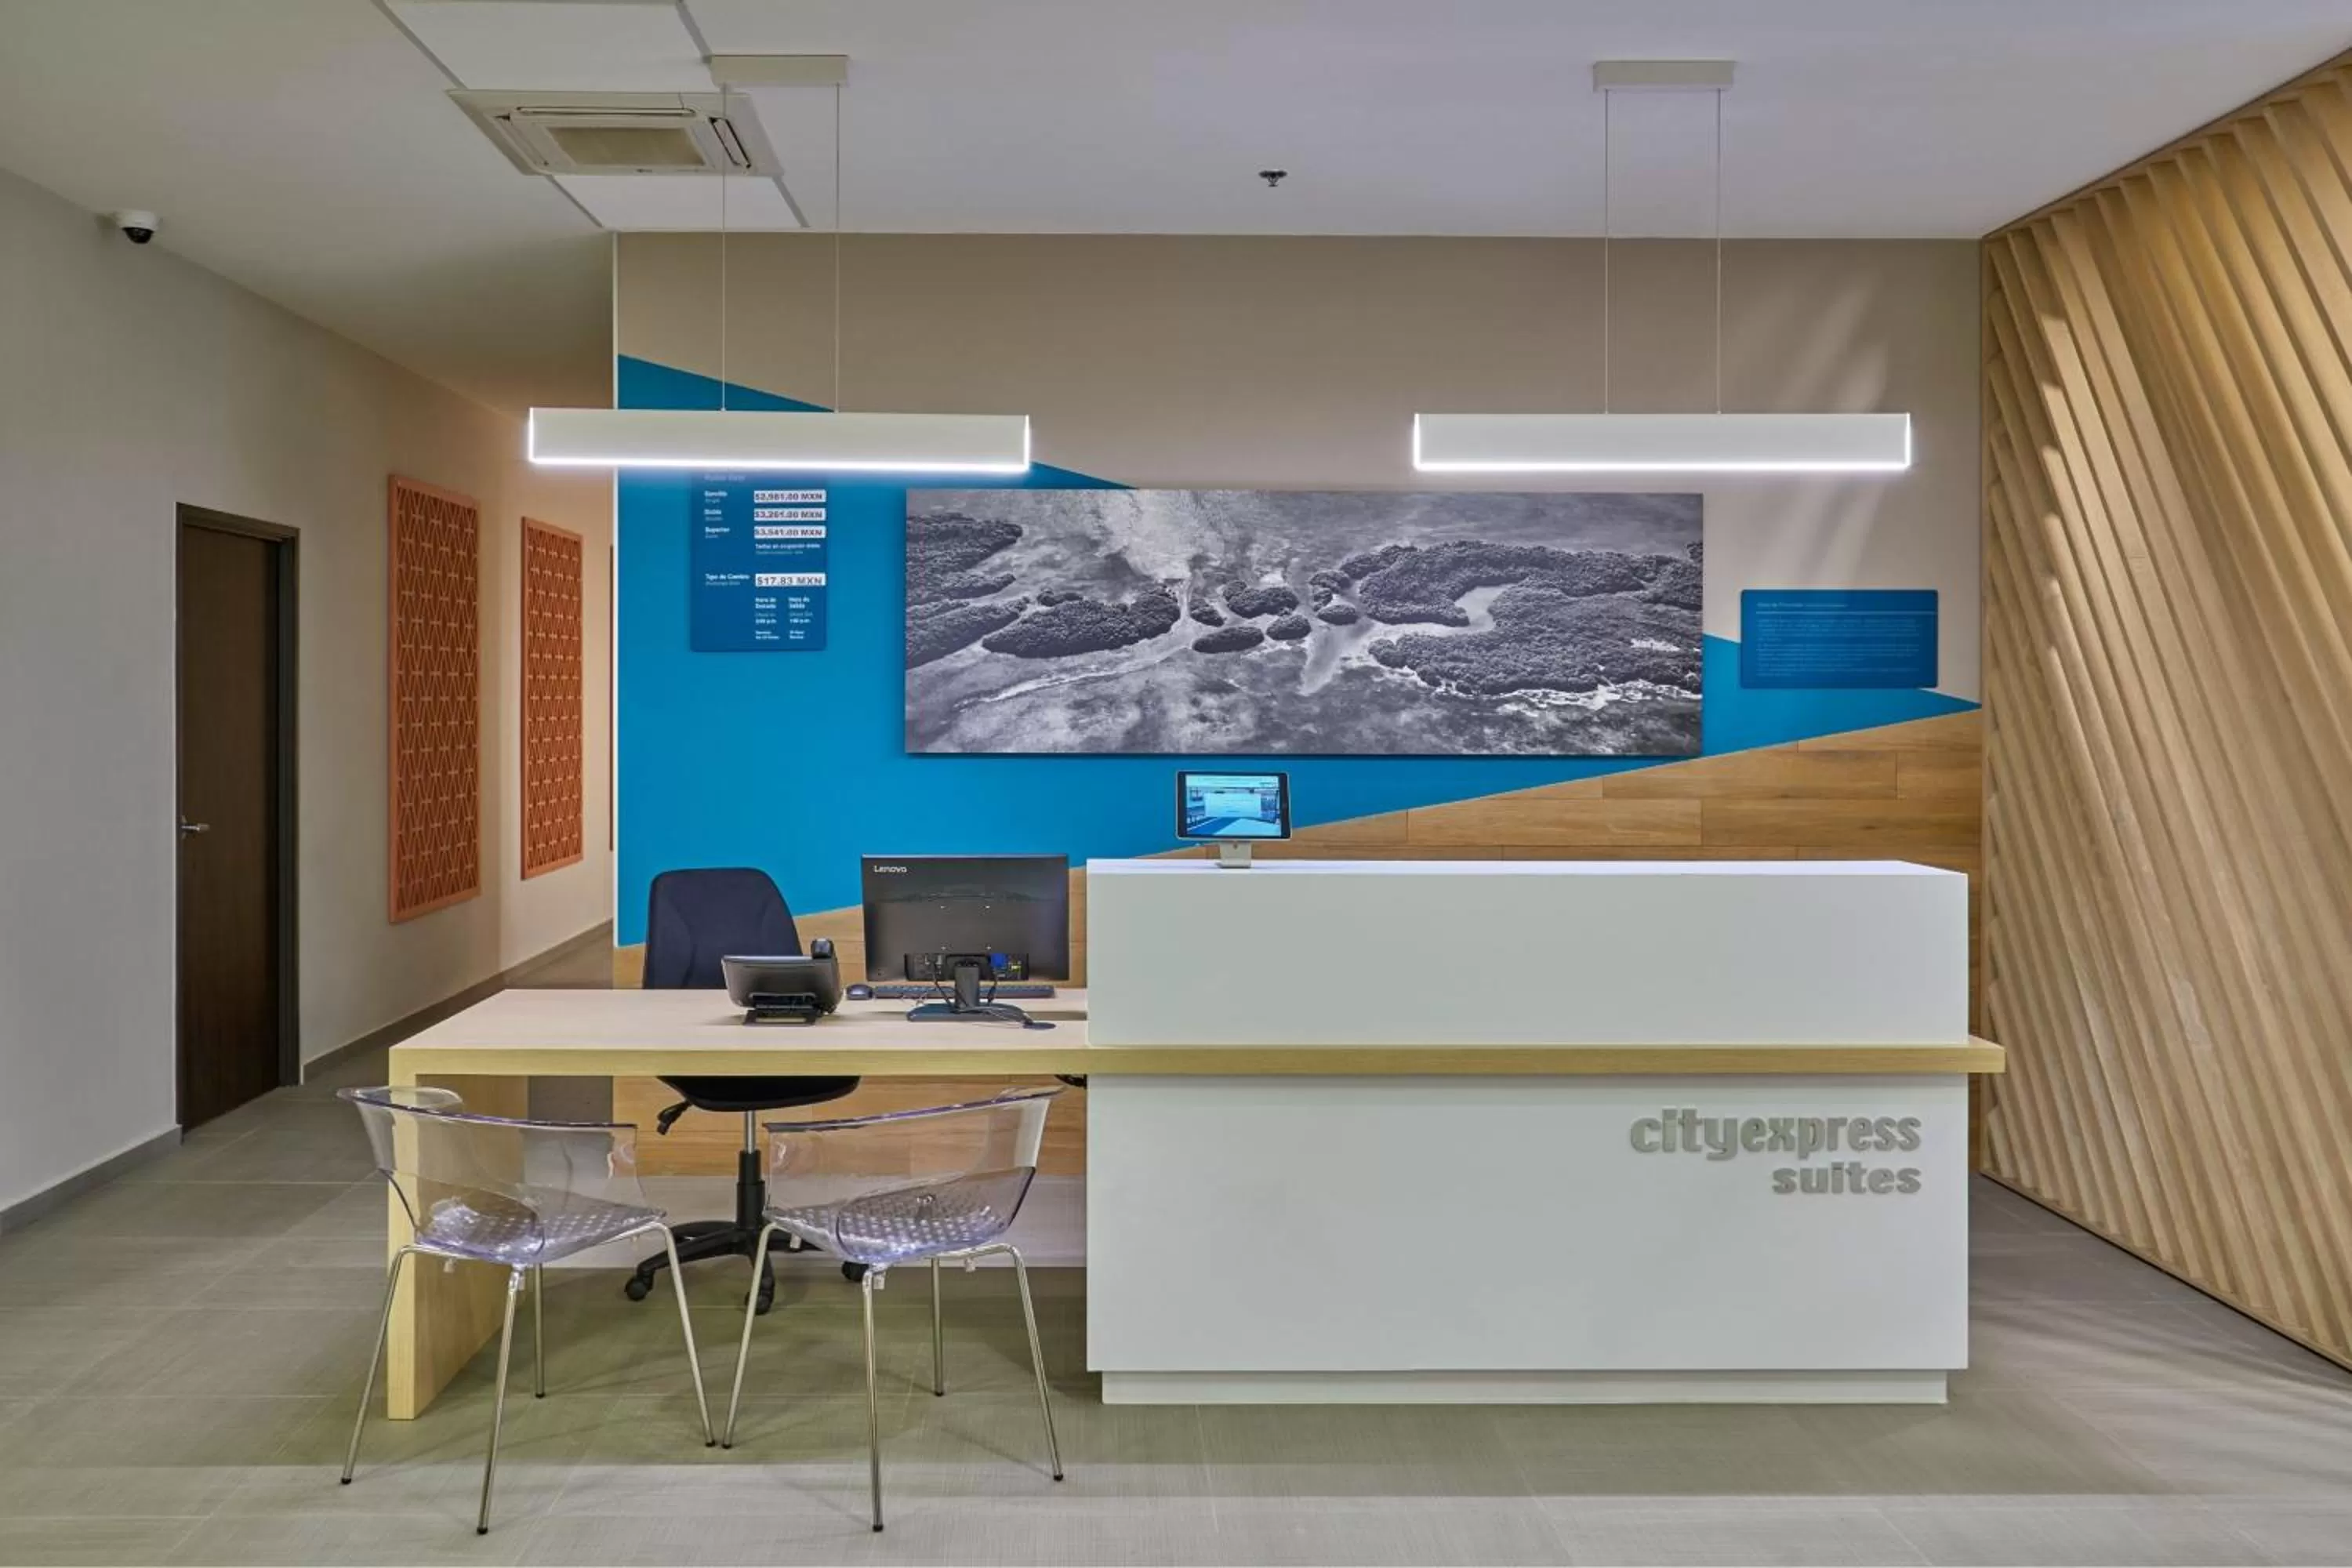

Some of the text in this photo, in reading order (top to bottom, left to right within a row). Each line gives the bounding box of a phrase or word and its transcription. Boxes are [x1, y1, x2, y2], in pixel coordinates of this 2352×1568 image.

[757, 576, 822, 585] $17.83 MXN
[1772, 1161, 1922, 1194] suites
